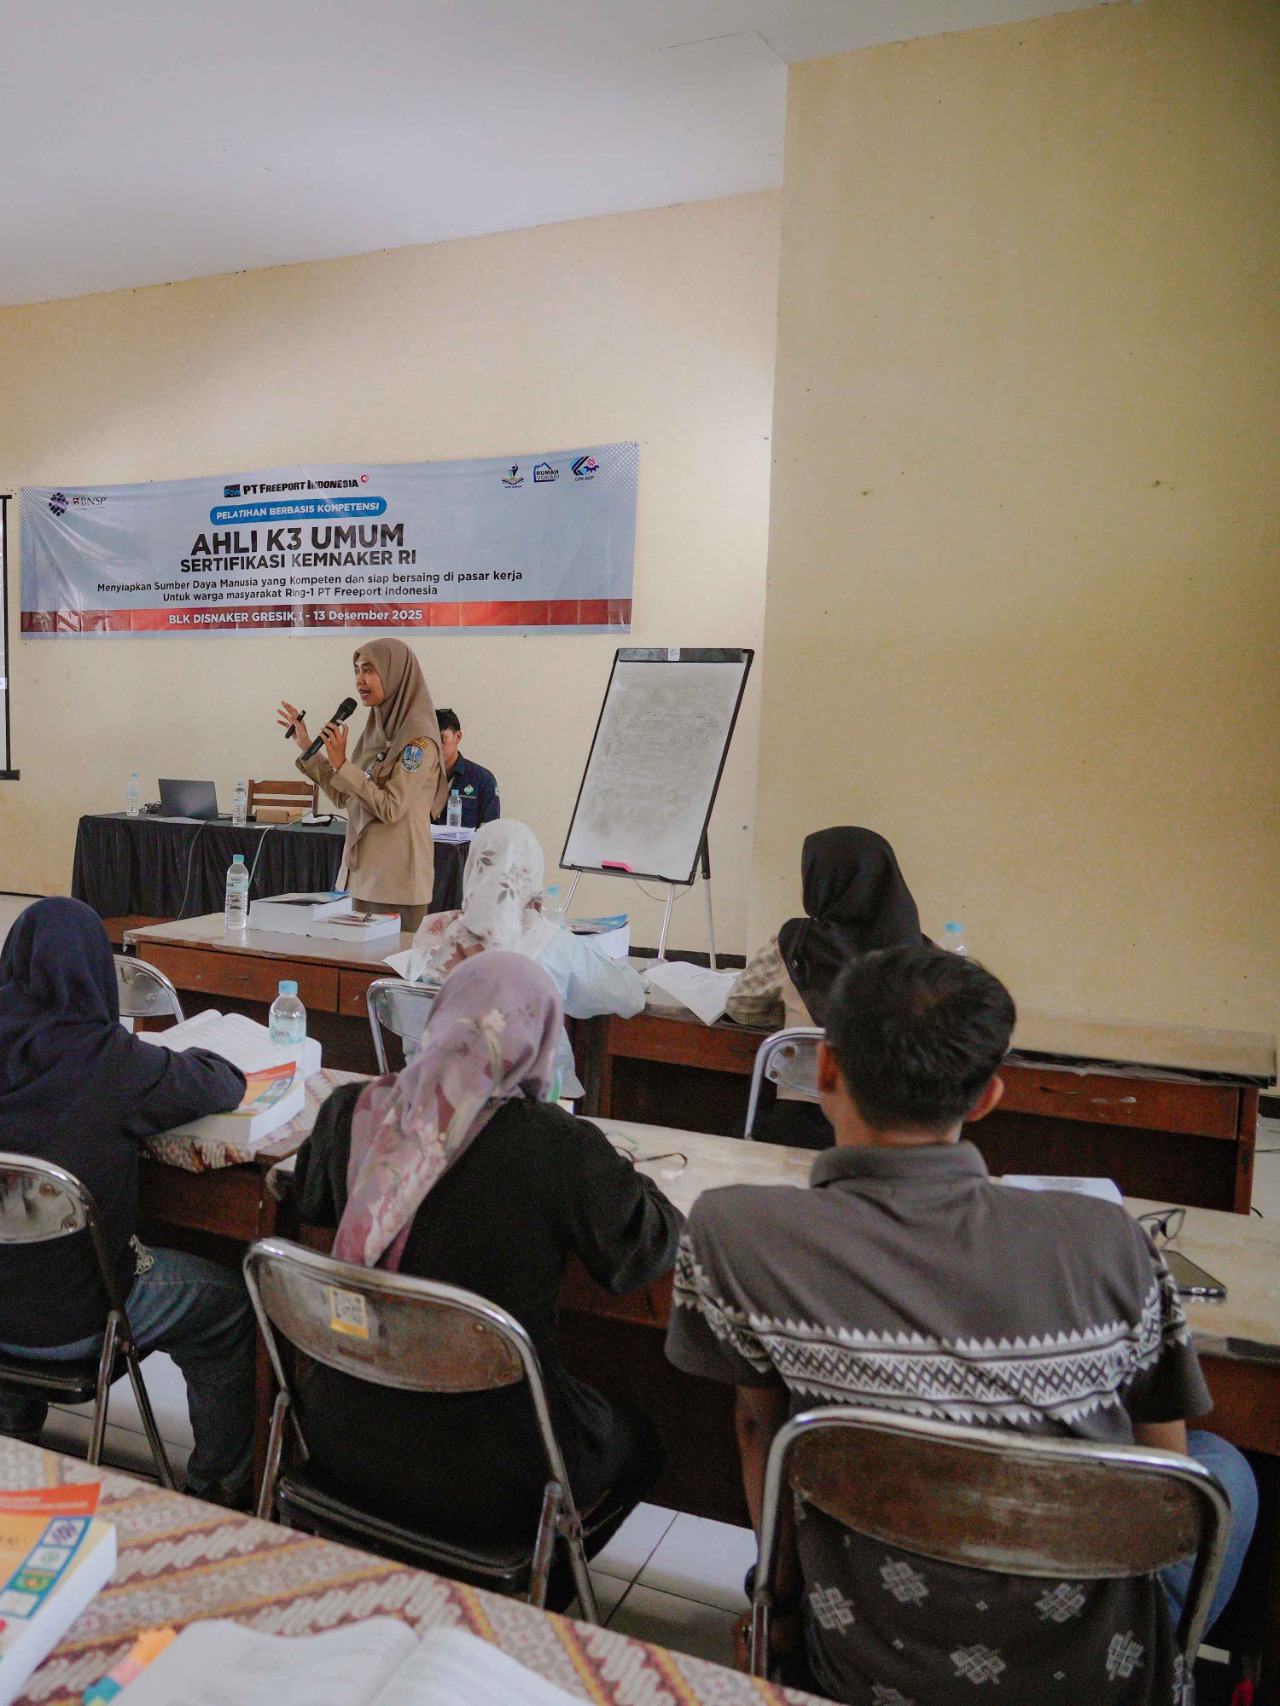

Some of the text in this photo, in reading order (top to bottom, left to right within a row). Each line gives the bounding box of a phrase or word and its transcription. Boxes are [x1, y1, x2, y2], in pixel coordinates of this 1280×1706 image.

[243, 485, 258, 495] PT
[216, 502, 380, 520] PELATIHAN BERBASIS KOMPETENSI
[190, 523, 405, 556] AHLI K3 UMUM
[180, 550, 416, 573] SERTIFIKASI KEMNAKER RI
[97, 570, 523, 594] Menyiapkan Sumber Daya Manusia yang Kompeten dan siap bersaing di pasar kerja
[163, 585, 438, 602] Untuk warga masyarakat Ring-1 PT Freeport Indonesia
[169, 614, 191, 624] BLK
[193, 612, 249, 623] DISNAKER
[251, 612, 296, 622] GRESIK,
[297, 611, 303, 621] 1
[313, 610, 326, 620] 13
[328, 610, 388, 620] Desember
[392, 609, 423, 620] 2025
